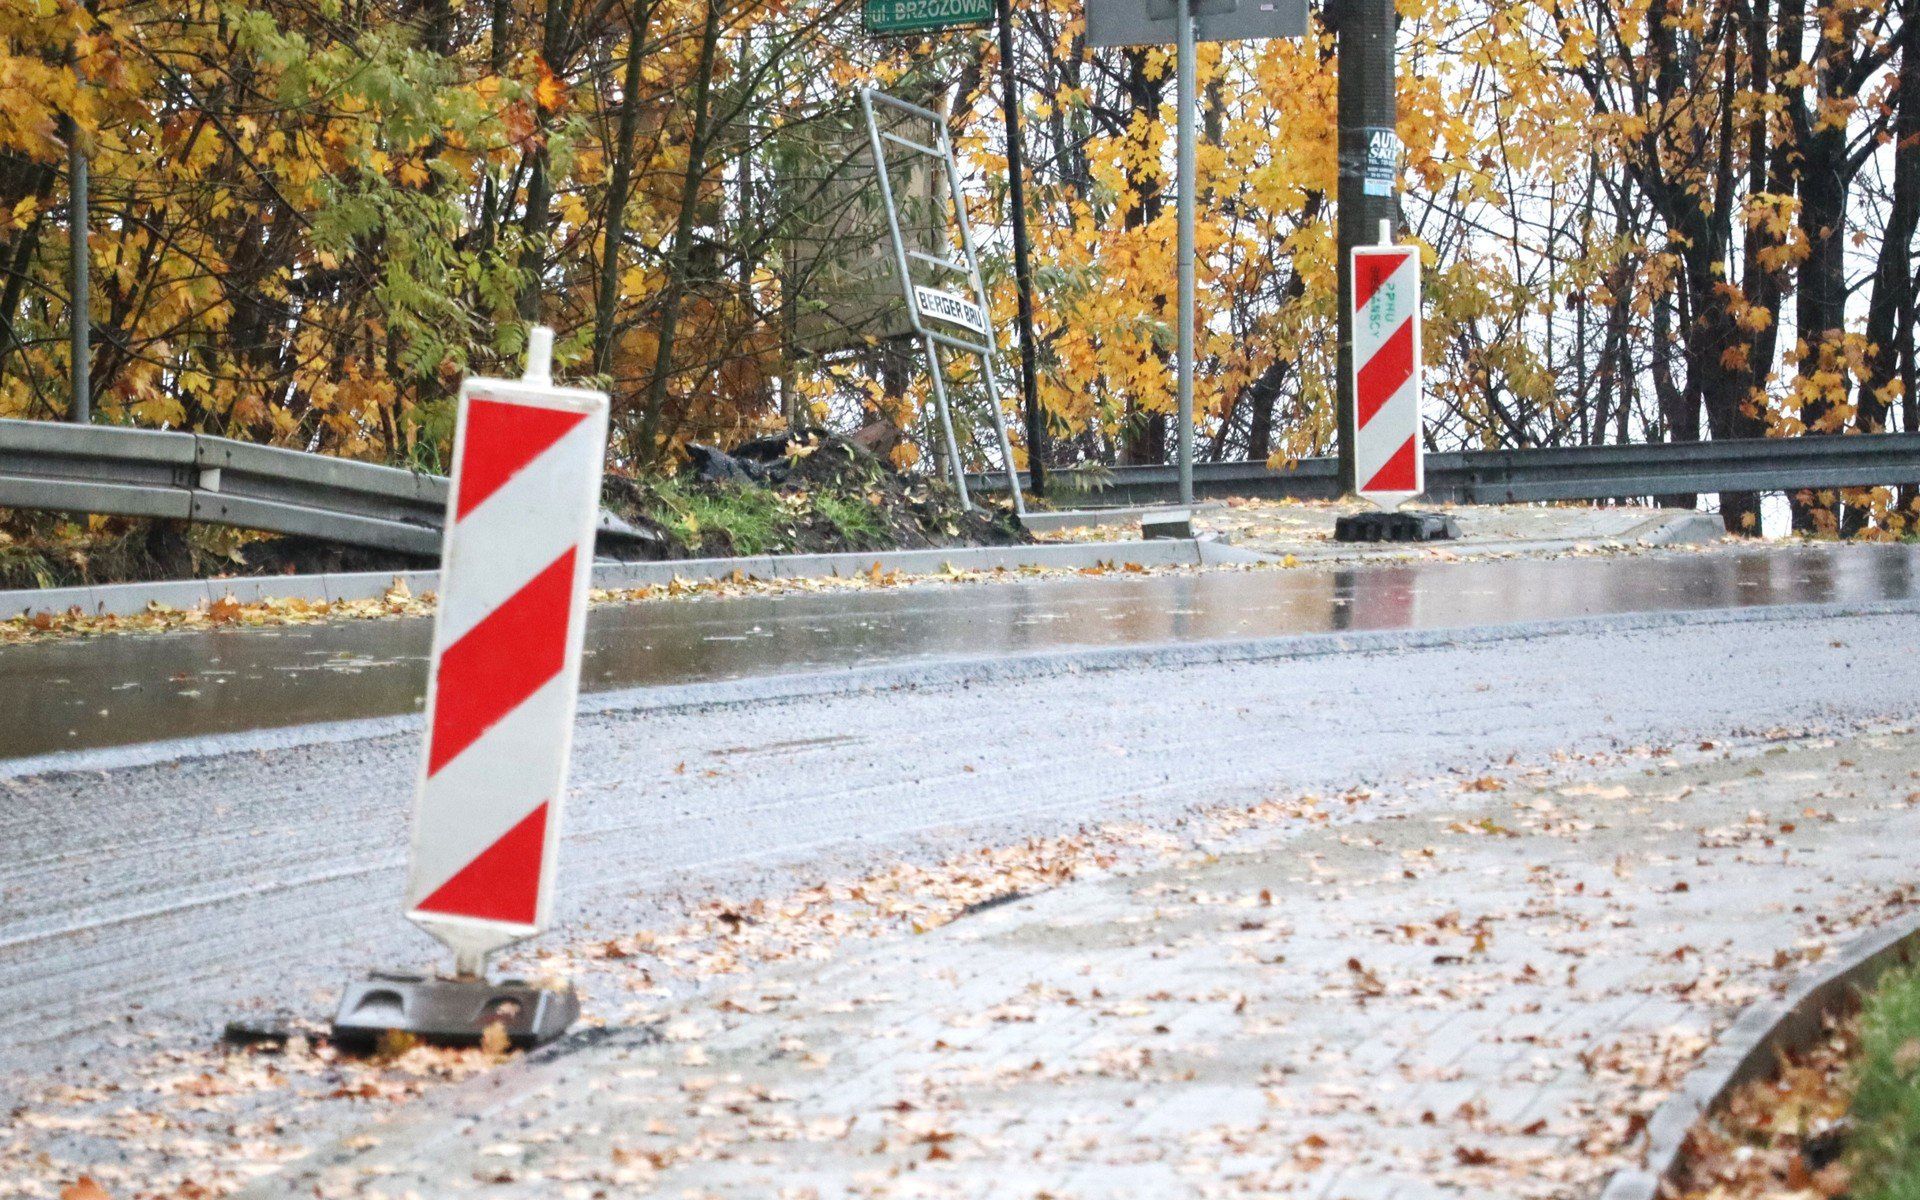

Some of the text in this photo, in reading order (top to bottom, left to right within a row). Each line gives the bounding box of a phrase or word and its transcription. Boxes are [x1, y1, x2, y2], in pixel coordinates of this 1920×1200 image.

[872, 0, 989, 23] ul. BRZOZOWA
[918, 291, 963, 318] BERGER
